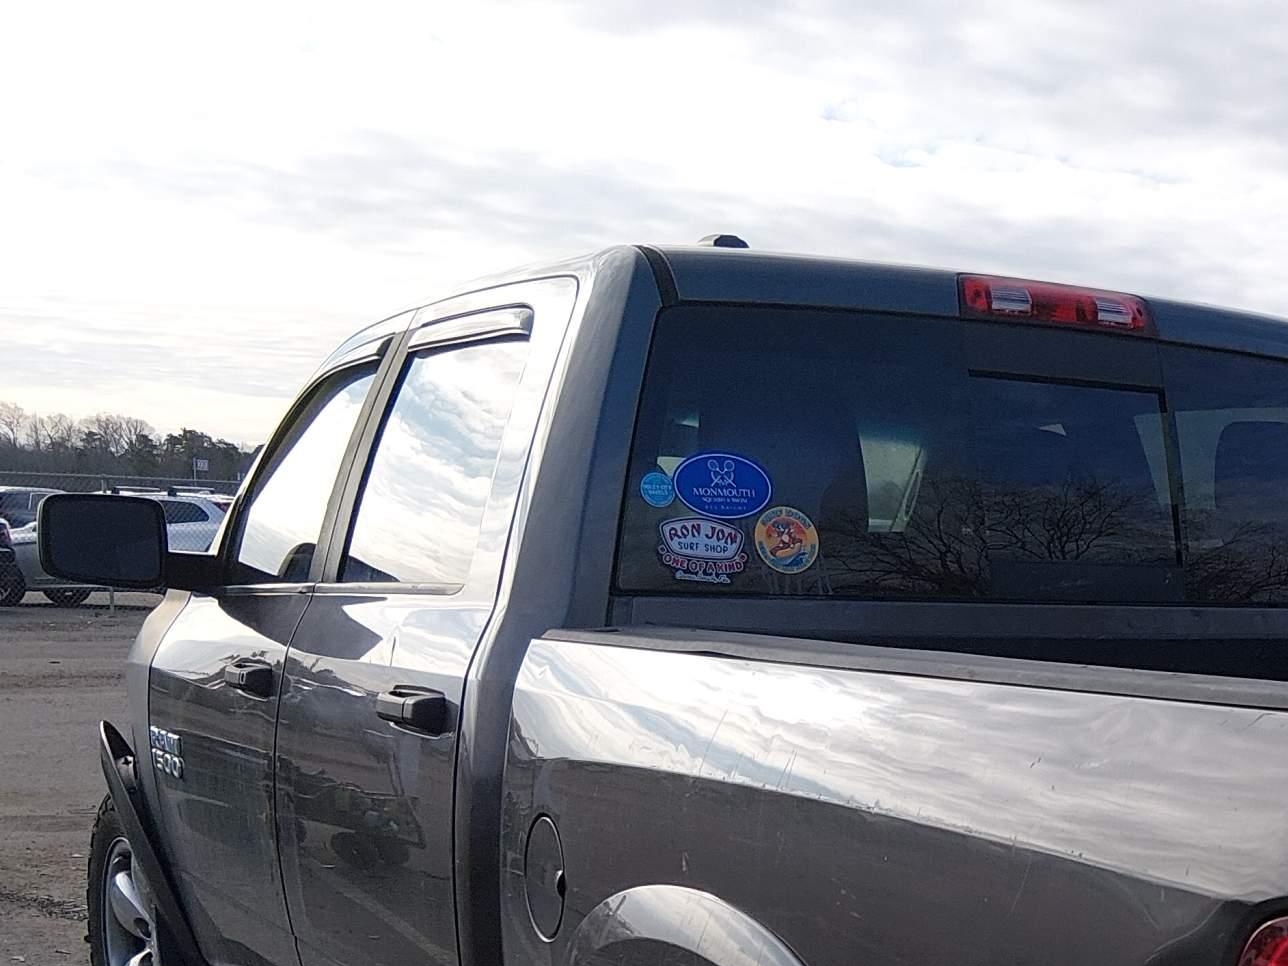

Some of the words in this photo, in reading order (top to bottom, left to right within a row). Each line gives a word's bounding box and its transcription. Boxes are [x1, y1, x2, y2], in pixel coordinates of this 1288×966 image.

[692, 487, 756, 498] MONMOUTH
[669, 523, 701, 542] RON
[704, 526, 738, 546] JON
[677, 541, 700, 551] SURF
[704, 543, 729, 554] SHOP
[689, 558, 705, 572] OF
[706, 561, 716, 573] A
